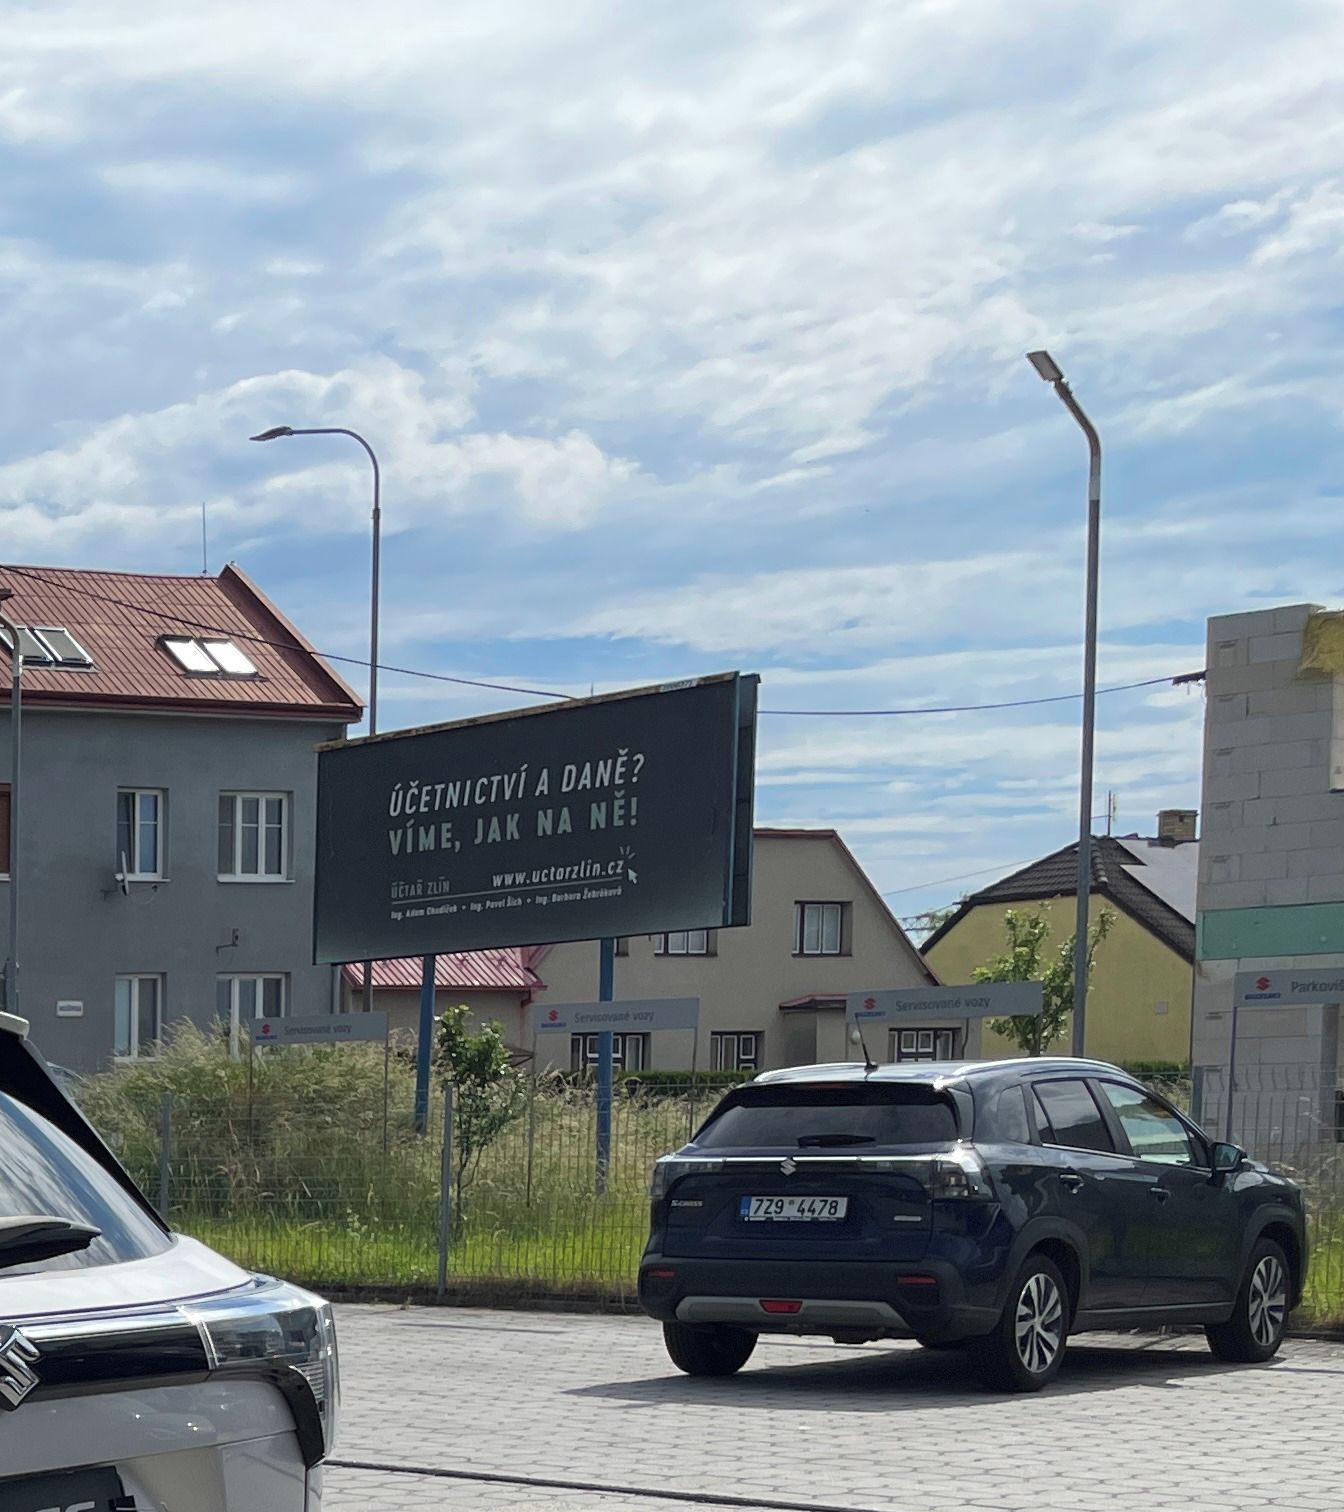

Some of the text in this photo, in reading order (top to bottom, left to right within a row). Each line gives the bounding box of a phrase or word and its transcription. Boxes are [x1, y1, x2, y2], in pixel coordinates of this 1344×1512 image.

[389, 748, 645, 817] ÚČETNICTVÍ A DANĚ?
[389, 790, 638, 856] VÍME, JAK NA NĚ!
[492, 859, 625, 888] www.uctarzlin.cz
[753, 1198, 785, 1215] 7Z9
[797, 1199, 839, 1216] 4478
